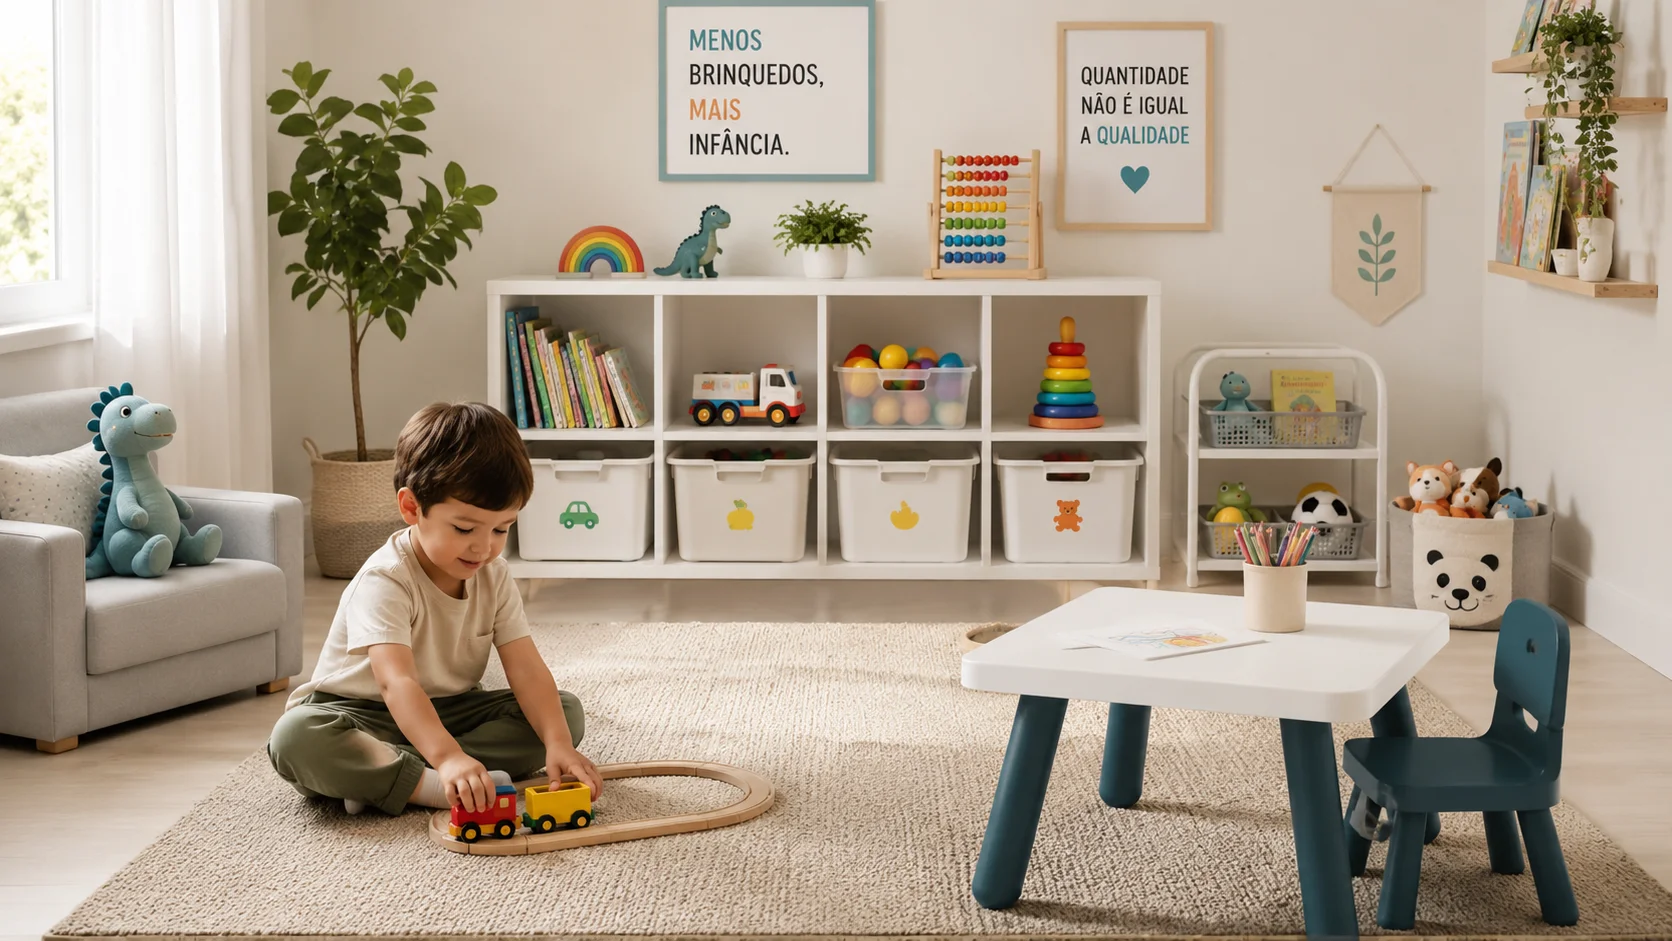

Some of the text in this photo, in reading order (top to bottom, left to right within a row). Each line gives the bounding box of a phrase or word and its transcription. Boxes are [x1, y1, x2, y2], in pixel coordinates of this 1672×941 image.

[689, 29, 762, 51] MENOS
[689, 63, 824, 88] BRINQUEDOS,
[1081, 66, 1189, 86] QUANTIDADE
[689, 98, 741, 120] MAIS
[1123, 92, 1132, 115] É
[1139, 96, 1188, 115] IGUAL
[689, 128, 789, 155] INFÂNCIA.
[1080, 126, 1189, 145] A QUALIDADE
